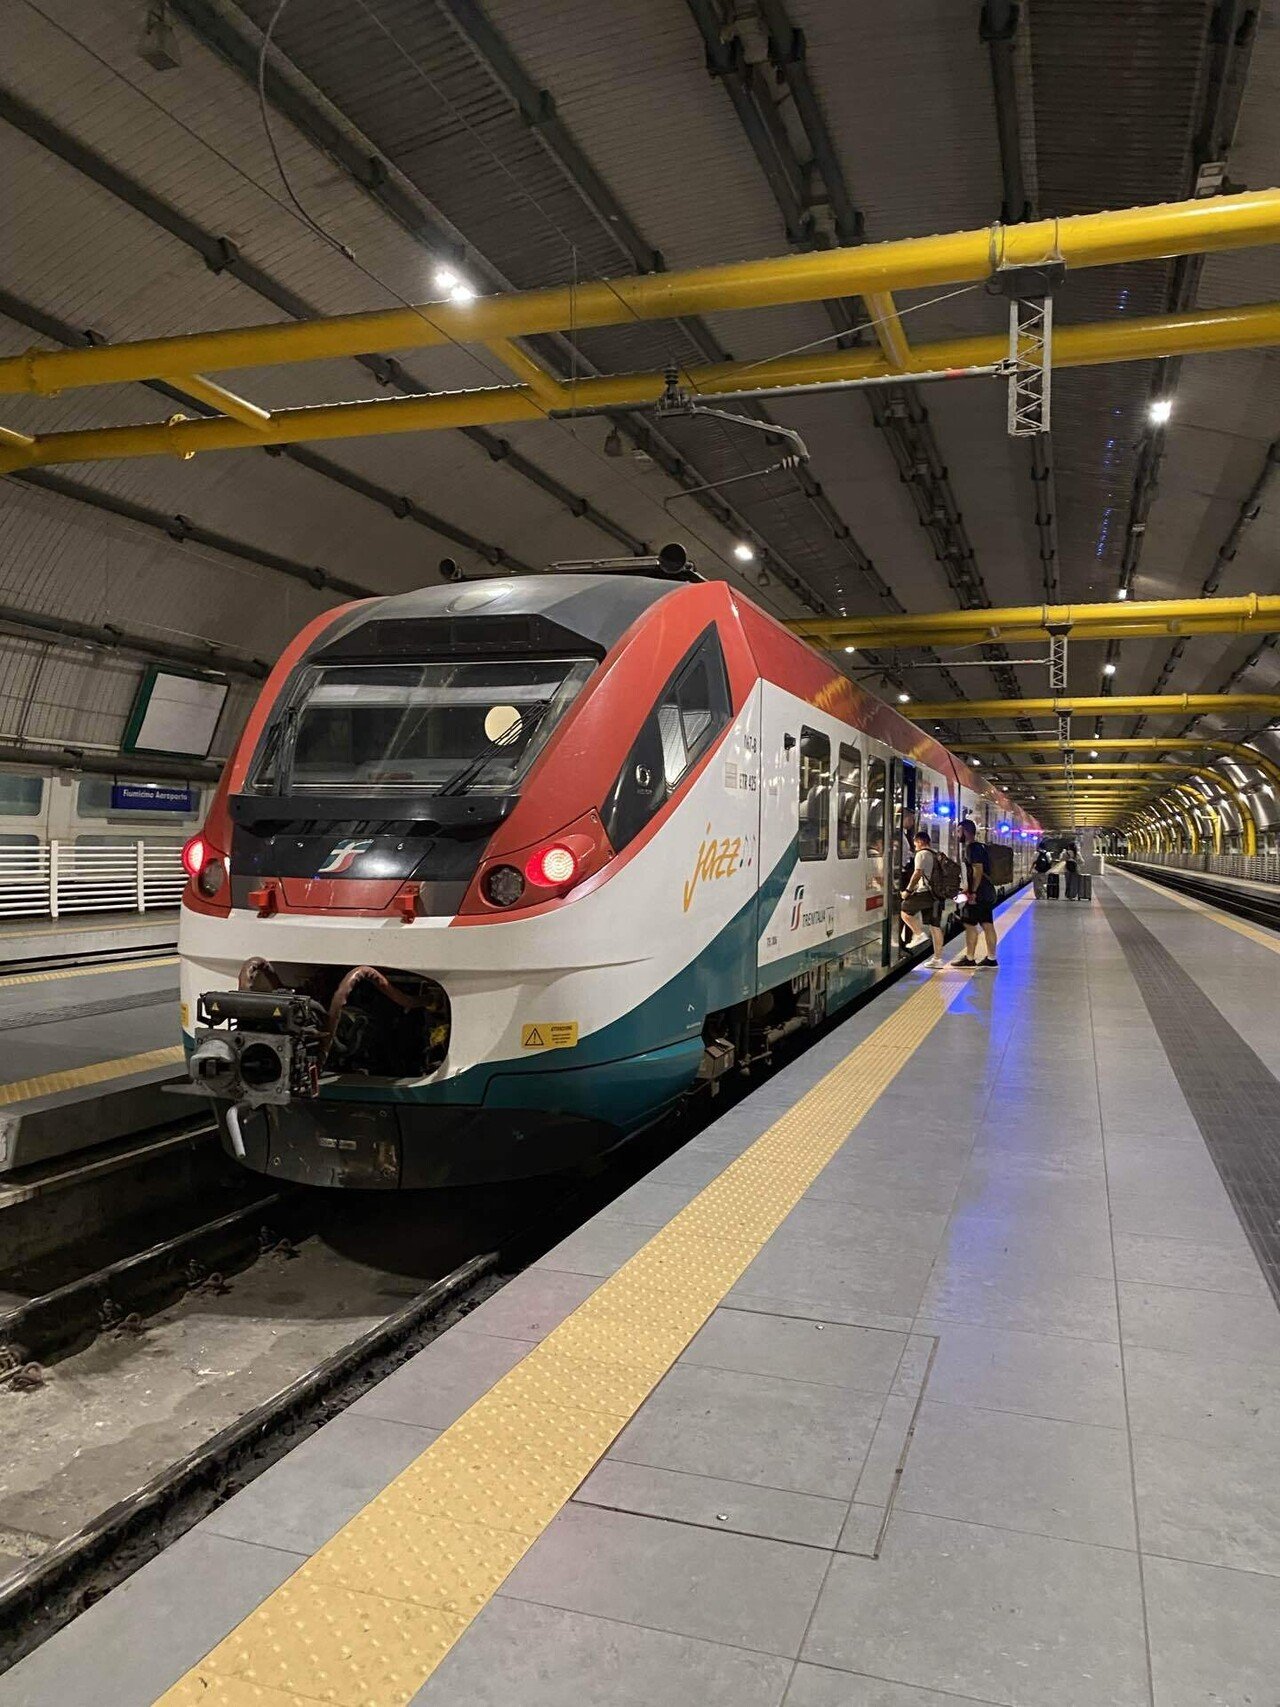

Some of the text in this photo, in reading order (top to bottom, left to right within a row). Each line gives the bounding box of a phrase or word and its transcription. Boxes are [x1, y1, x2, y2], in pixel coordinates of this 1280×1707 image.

[123, 789, 187, 801] Fiumicino Aeroporto
[683, 821, 741, 912] jazz
